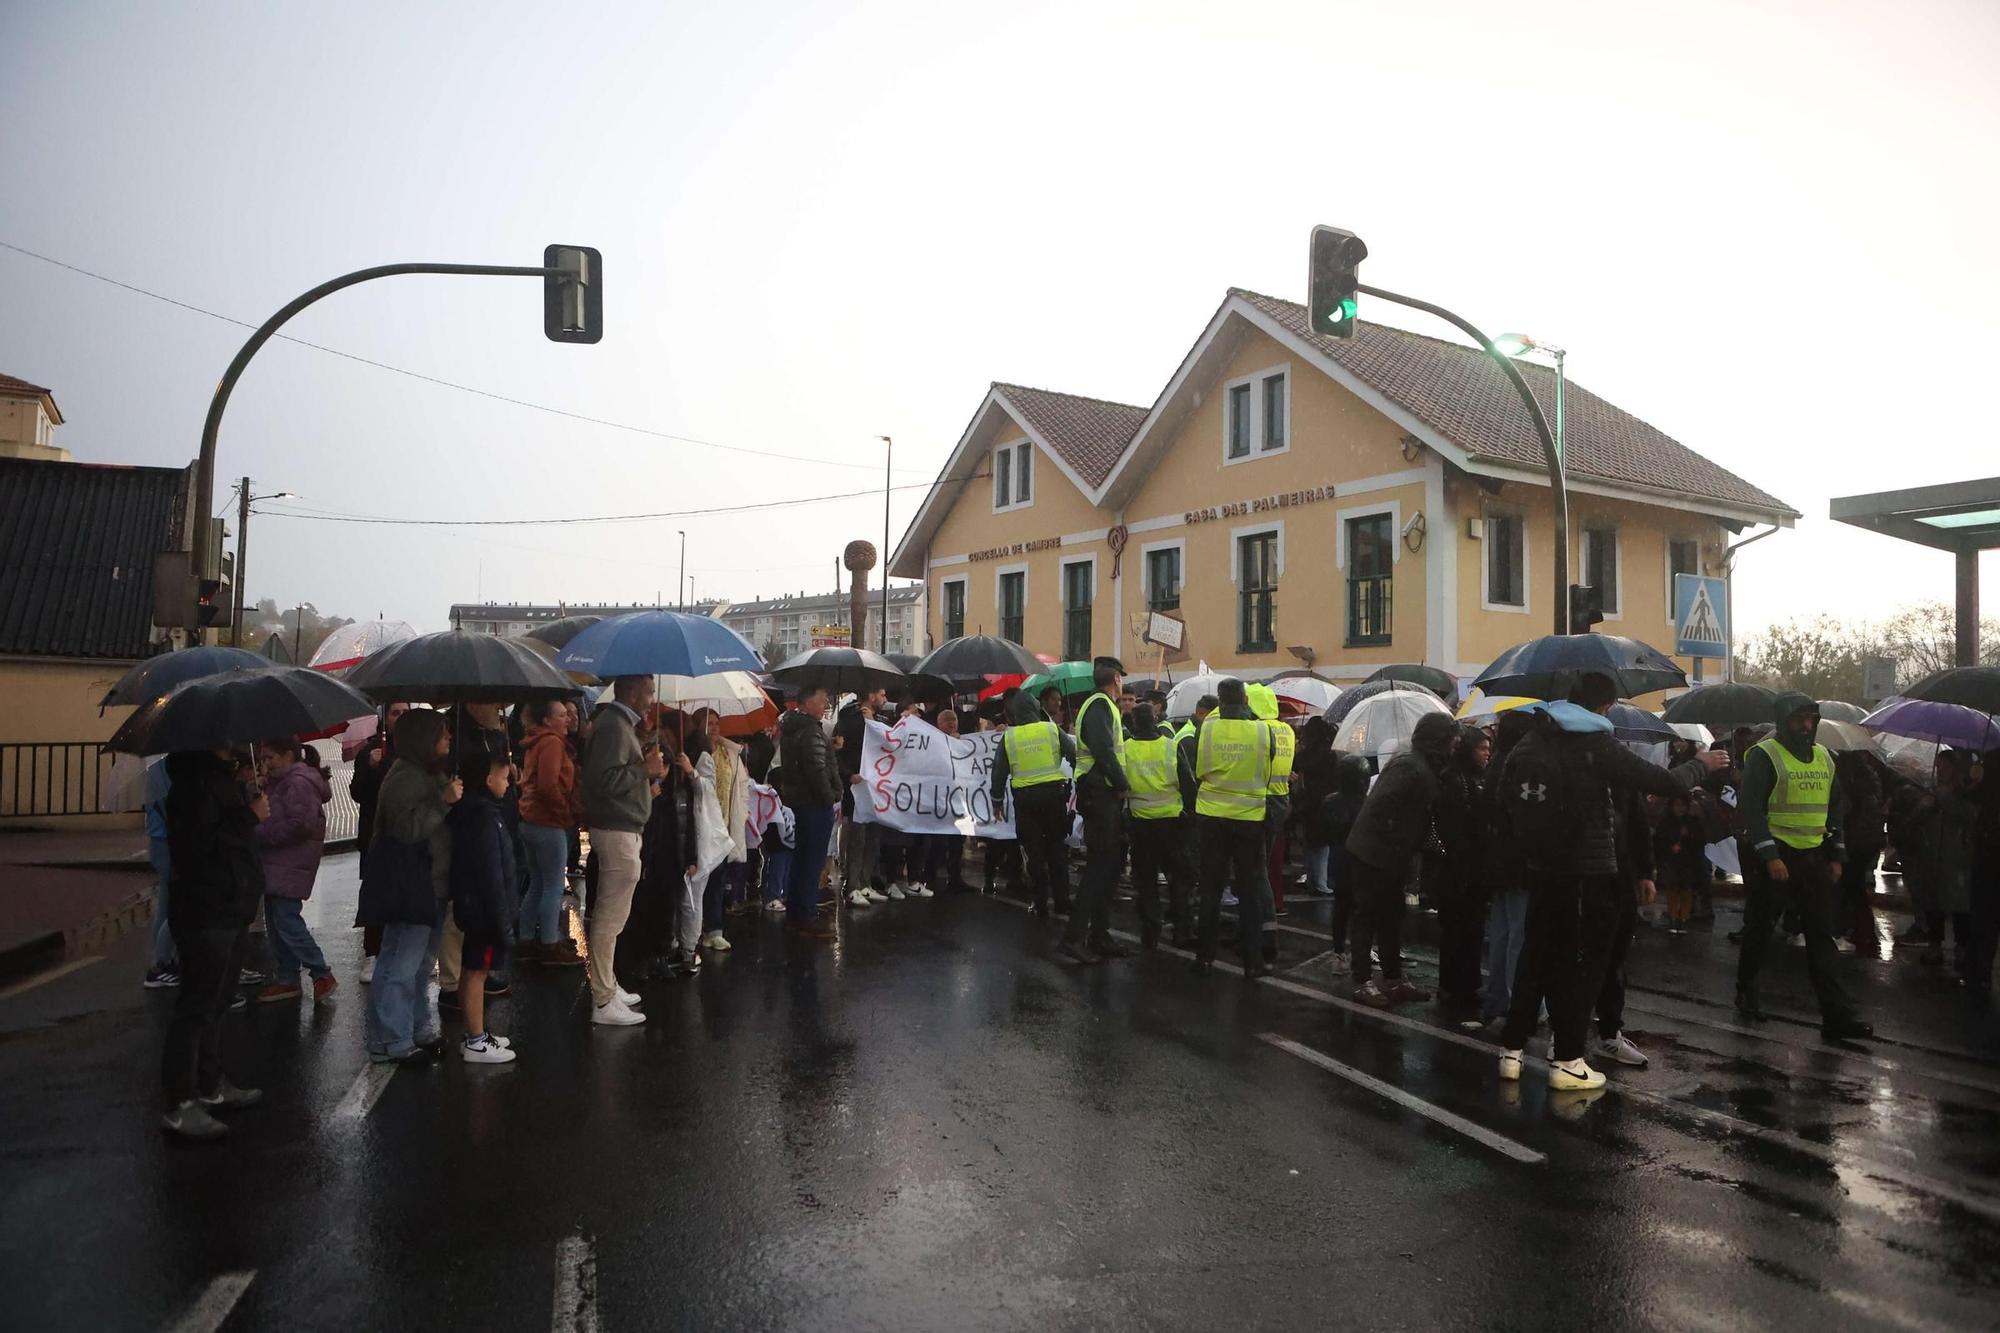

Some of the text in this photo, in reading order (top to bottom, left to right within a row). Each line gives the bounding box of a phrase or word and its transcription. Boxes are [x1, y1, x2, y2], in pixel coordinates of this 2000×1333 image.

[1184, 485, 1335, 524] CASA DAS PALMEIRAS
[968, 536, 1062, 562] CONCELLO DE CAMBRE
[881, 721, 930, 753] SEN
[1212, 743, 1254, 752] GUARDIA
[1788, 771, 1829, 780] GUARDIA
[1799, 781, 1823, 791] CIVIL
